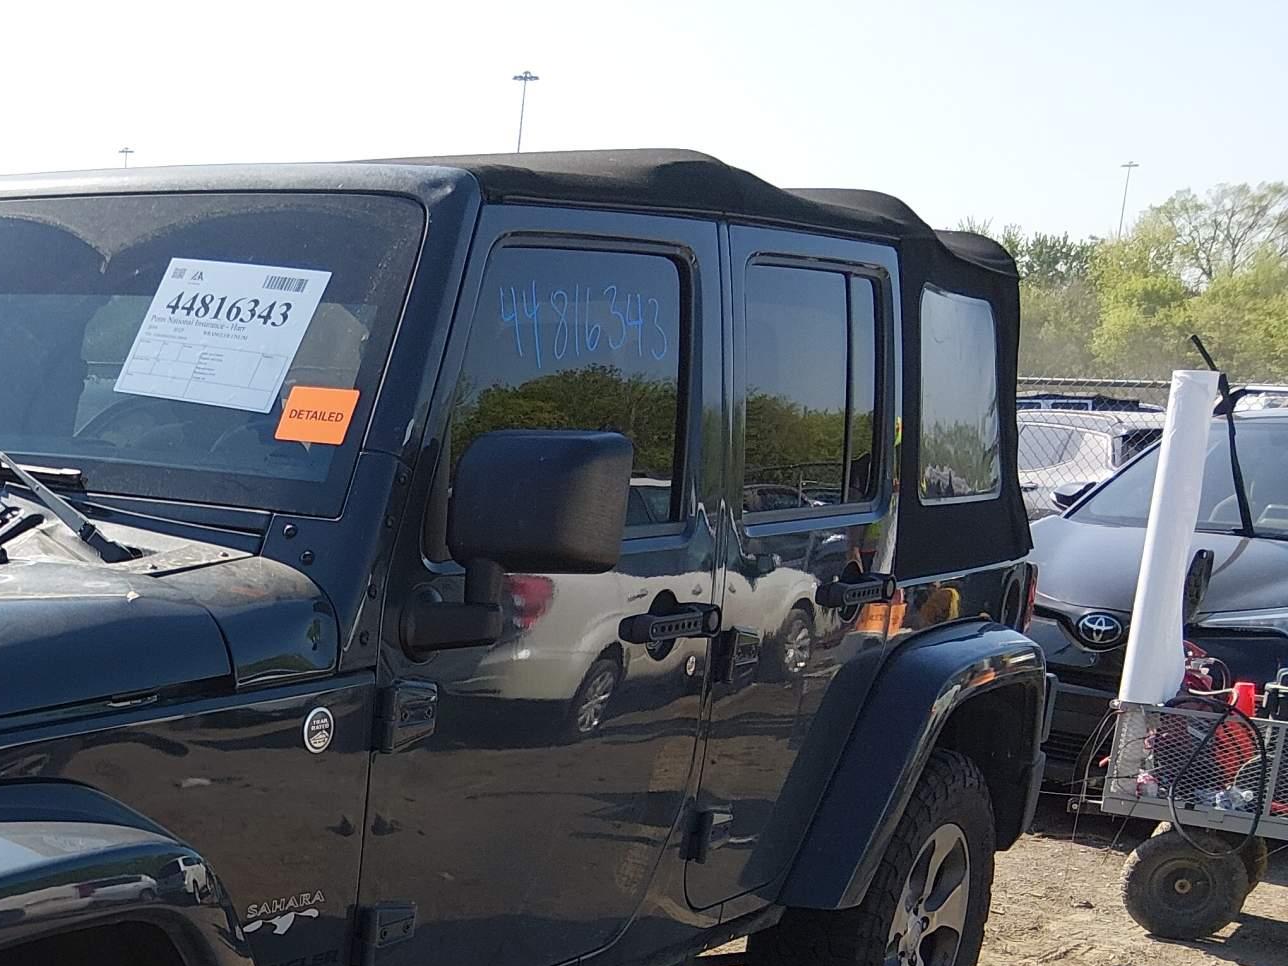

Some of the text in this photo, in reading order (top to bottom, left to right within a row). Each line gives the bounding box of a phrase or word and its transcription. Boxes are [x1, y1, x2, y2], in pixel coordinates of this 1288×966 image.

[166, 291, 293, 328] 44816343
[168, 316, 194, 326] National
[194, 319, 225, 330] Insurance
[499, 279, 668, 369] 44816343
[289, 408, 344, 423] DETAILED
[247, 889, 325, 919] SAHARA
